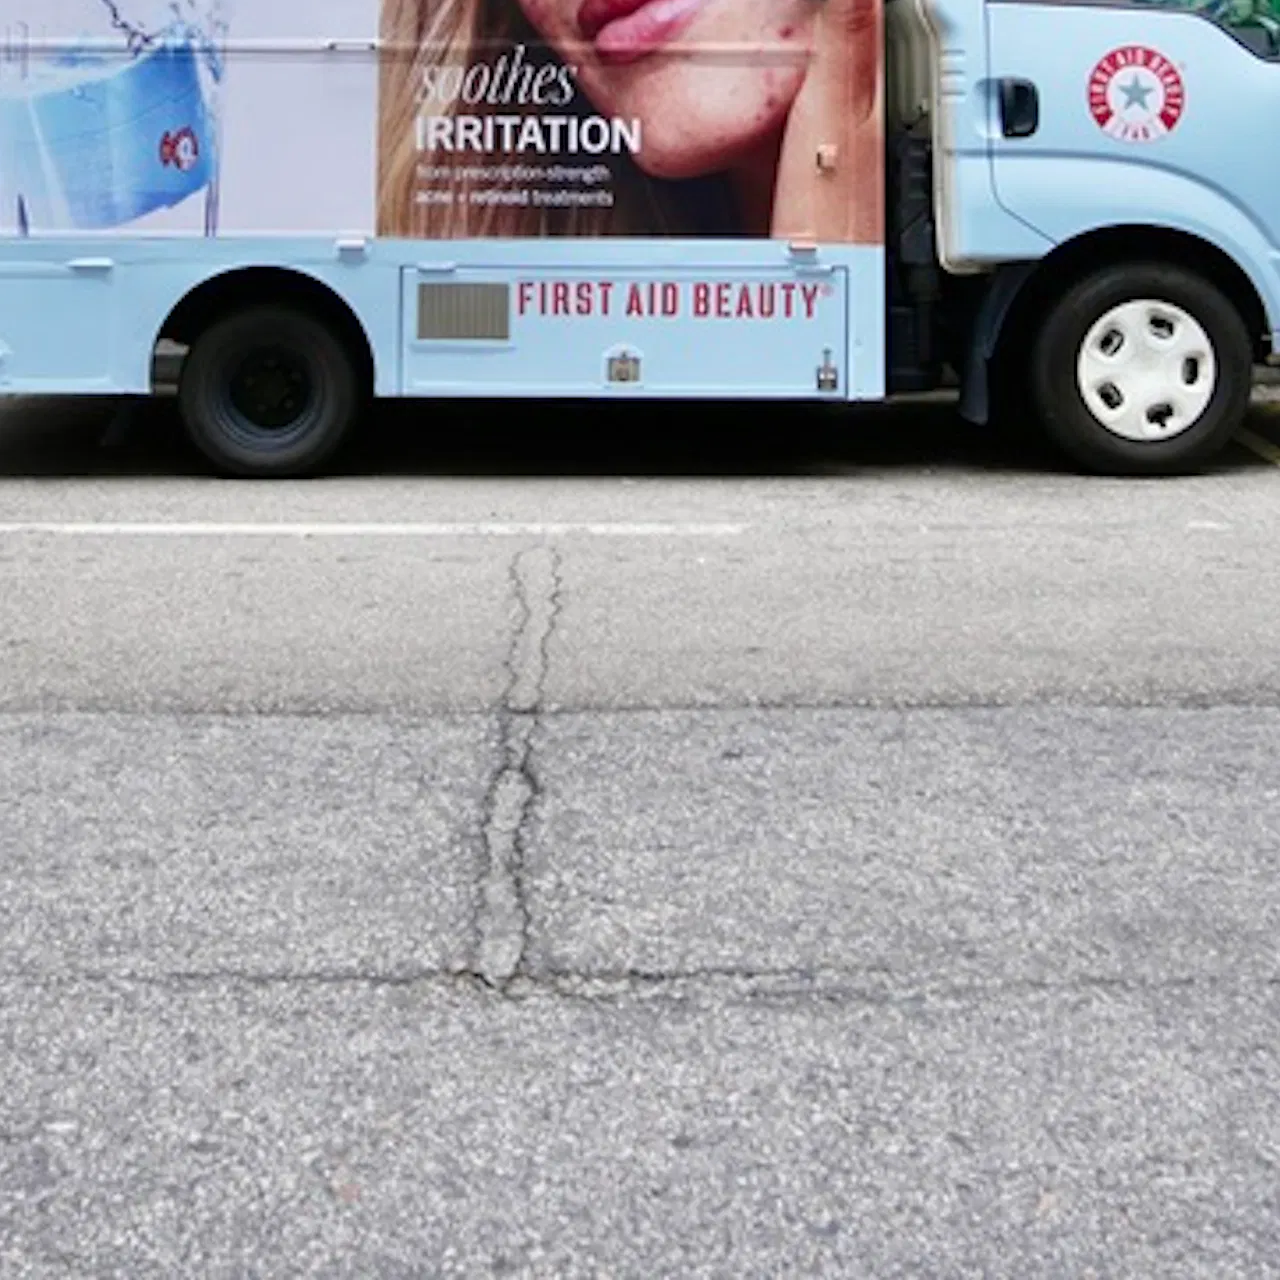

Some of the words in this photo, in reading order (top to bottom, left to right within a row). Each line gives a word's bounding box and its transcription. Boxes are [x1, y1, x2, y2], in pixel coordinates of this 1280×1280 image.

[415, 44, 578, 105] soothes
[415, 115, 642, 154] IRRITATION
[518, 281, 613, 316] FIRST
[625, 282, 678, 317] AID
